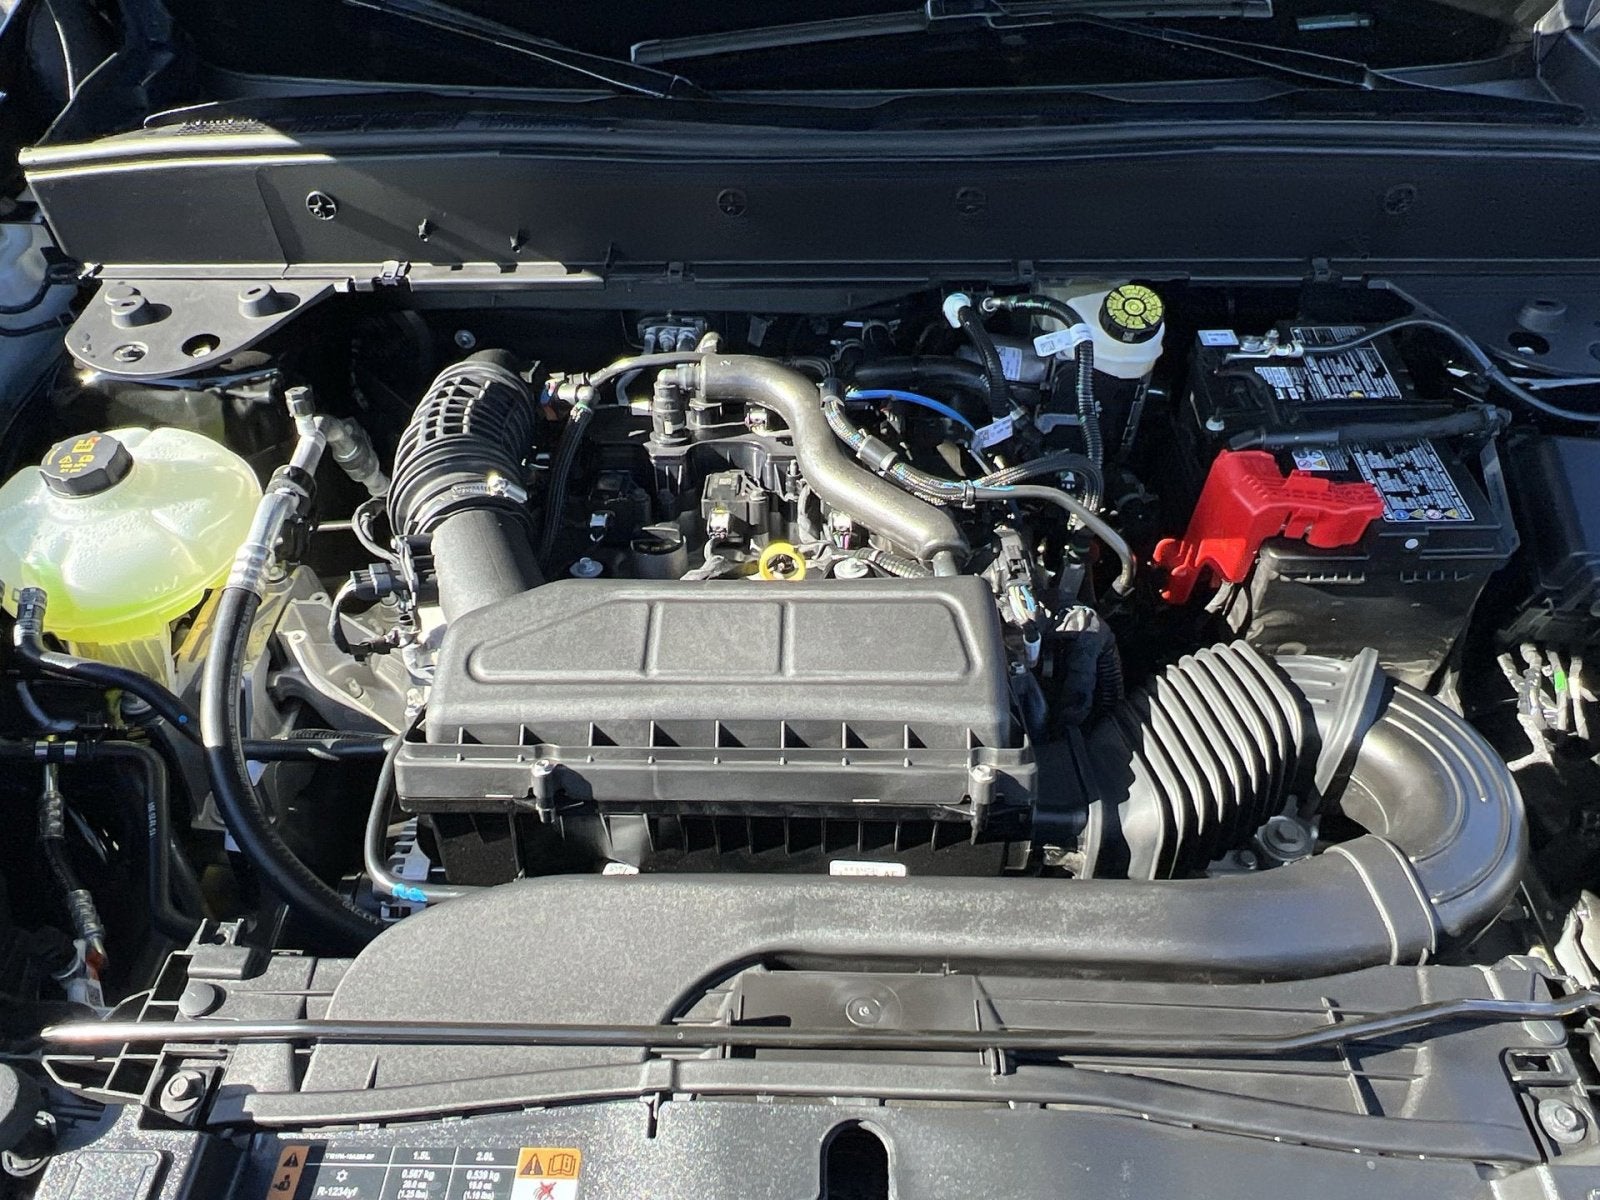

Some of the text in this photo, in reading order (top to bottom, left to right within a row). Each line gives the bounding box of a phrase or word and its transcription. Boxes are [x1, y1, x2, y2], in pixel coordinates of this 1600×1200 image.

[413, 1151, 431, 1160] 1.5L
[475, 1151, 495, 1161] 2.0L
[423, 1170, 435, 1181] kg
[489, 1171, 500, 1182] kg
[317, 1186, 359, 1199] R-1234yf
